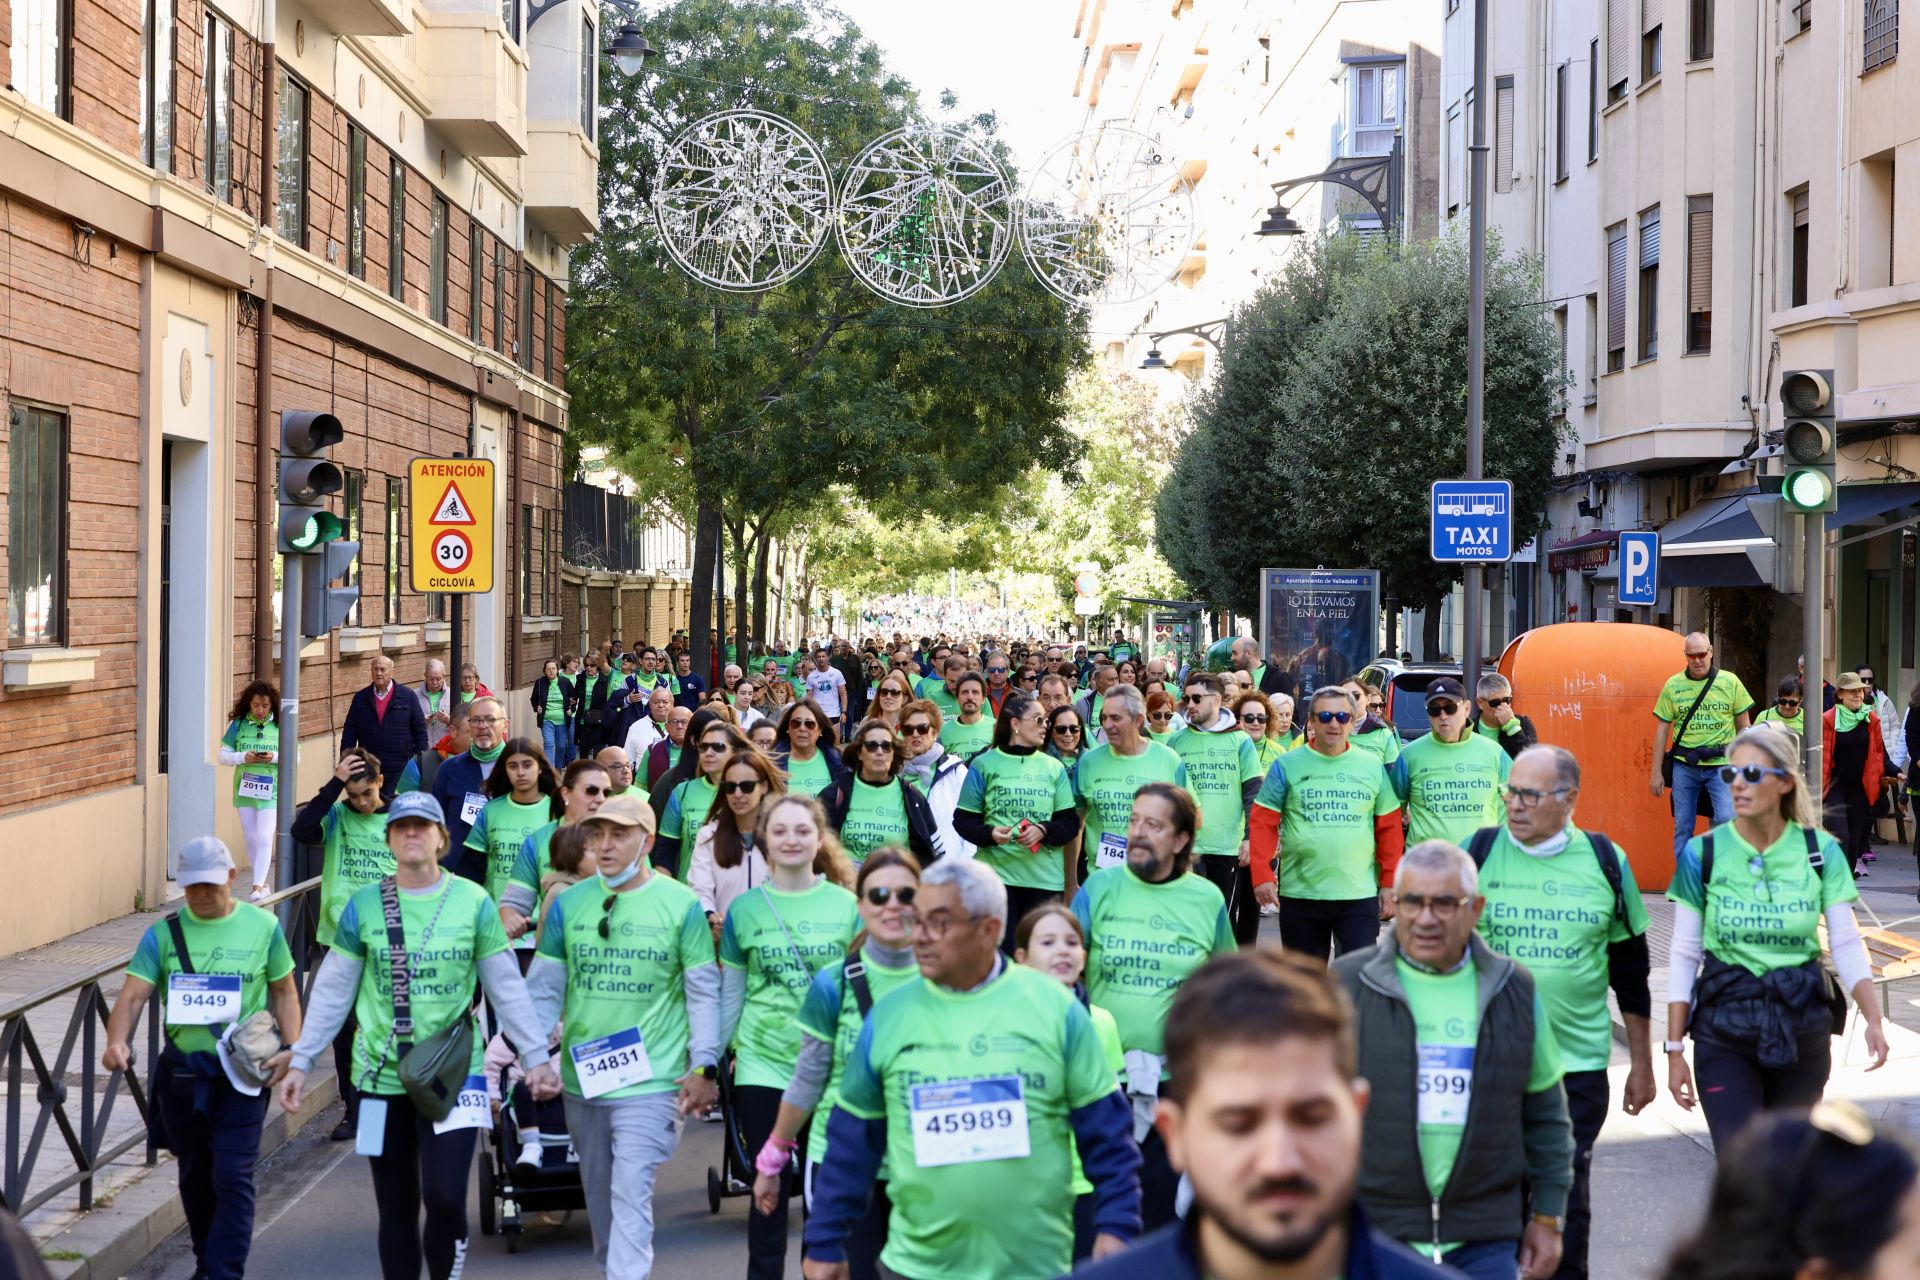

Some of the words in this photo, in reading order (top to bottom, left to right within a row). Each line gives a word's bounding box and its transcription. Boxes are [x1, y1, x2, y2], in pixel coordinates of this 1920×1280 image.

[421, 463, 485, 477] ATENCIÓN
[1445, 527, 1498, 545] TAXI
[440, 545, 464, 560] 30
[1457, 547, 1493, 555] MOTOS
[1626, 540, 1650, 594] P
[429, 576, 475, 587] CICLOVÍA
[1289, 596, 1301, 607] LO
[1303, 596, 1355, 606] LLEVAMOS
[1297, 608, 1311, 618] EN
[1313, 608, 1326, 618] LA
[1329, 609, 1349, 619] PIEL
[1700, 702, 1729, 711] archa
[253, 743, 277, 751] march
[1185, 763, 1197, 771] En
[1200, 762, 1236, 771] marcha
[1190, 771, 1216, 781] ontra
[244, 782, 269, 791] 20114
[1197, 781, 1229, 790] cáncer
[1426, 780, 1441, 790] En
[1445, 779, 1491, 789] marcha
[998, 786, 1011, 795] En
[1015, 787, 1055, 798] marcha
[1096, 790, 1110, 799] En
[1307, 789, 1322, 799] En
[1327, 790, 1371, 800] marcha
[1426, 792, 1468, 802] contra
[997, 799, 1034, 807] contra
[1097, 802, 1132, 812] contra
[1307, 800, 1348, 810] contra
[1442, 802, 1484, 813] cáncer
[1011, 808, 1050, 819] cáncer
[1308, 812, 1318, 822] el
[1323, 811, 1362, 822] cáncer
[847, 821, 860, 829] En
[865, 823, 906, 833] marcha
[846, 832, 884, 842] contra
[344, 845, 355, 855] En
[1104, 847, 1128, 859] 184
[344, 858, 378, 868] contra
[342, 868, 351, 877] el
[1722, 896, 1744, 911] En
[1494, 903, 1518, 918] En
[1524, 908, 1599, 924] marcha
[1721, 915, 1784, 929] contra
[1494, 924, 1558, 939] contra
[1743, 931, 1808, 946] cáncer
[1107, 935, 1125, 949] En
[1131, 939, 1196, 956] marcha
[1495, 940, 1509, 956] el
[1516, 942, 1583, 959] cáncer
[579, 944, 598, 957] En
[604, 947, 668, 961] marcha
[762, 946, 782, 959] En
[580, 962, 631, 976] contra
[1103, 955, 1160, 971] contra
[391, 944, 409, 1006] PRUNE
[1104, 969, 1117, 983] el
[411, 981, 461, 996] áncer
[597, 979, 654, 993] cáncer
[183, 994, 227, 1007] 9449
[586, 1049, 638, 1076] 34831
[926, 1108, 1012, 1134] 45989
